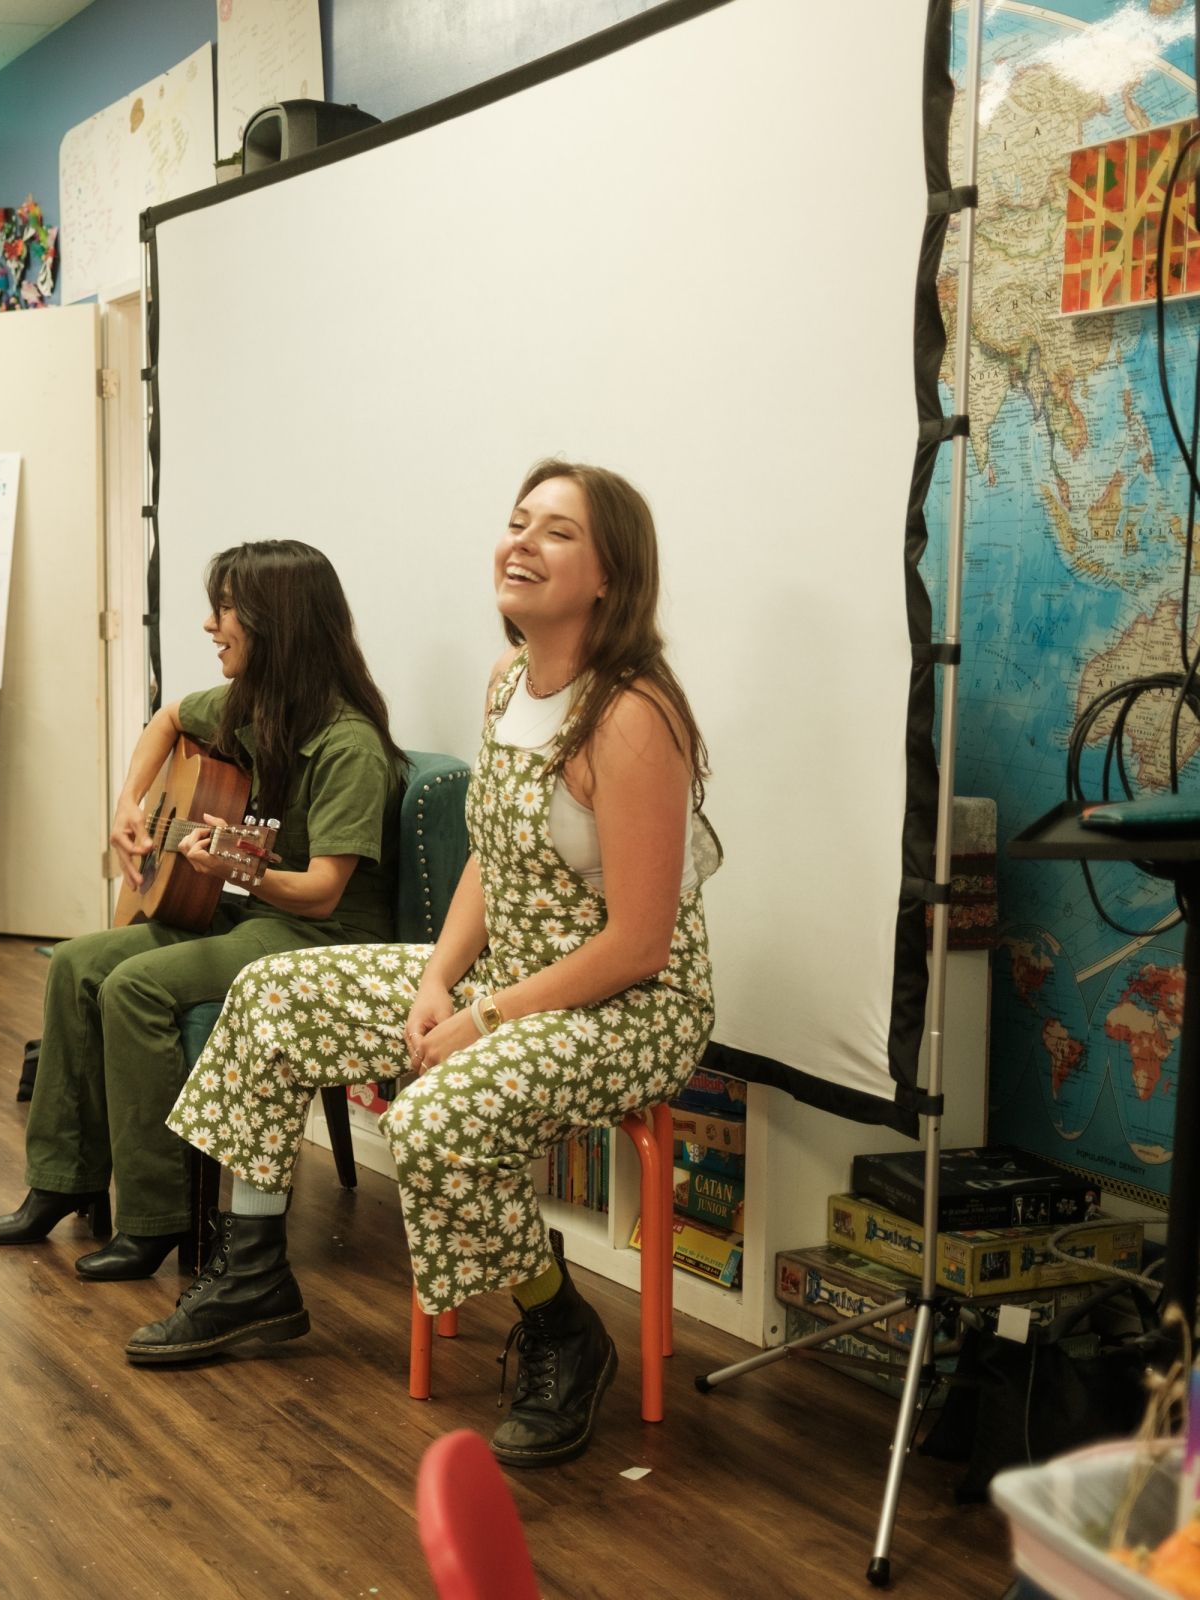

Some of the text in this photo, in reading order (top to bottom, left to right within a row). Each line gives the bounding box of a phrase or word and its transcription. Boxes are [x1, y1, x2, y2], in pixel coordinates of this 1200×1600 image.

[995, 290, 1053, 313] CHIN
[970, 369, 999, 381] NDIA
[1084, 527, 1174, 538] INDONESIA
[695, 1174, 734, 1203] CATAN
[696, 1198, 728, 1218] JUNIOR
